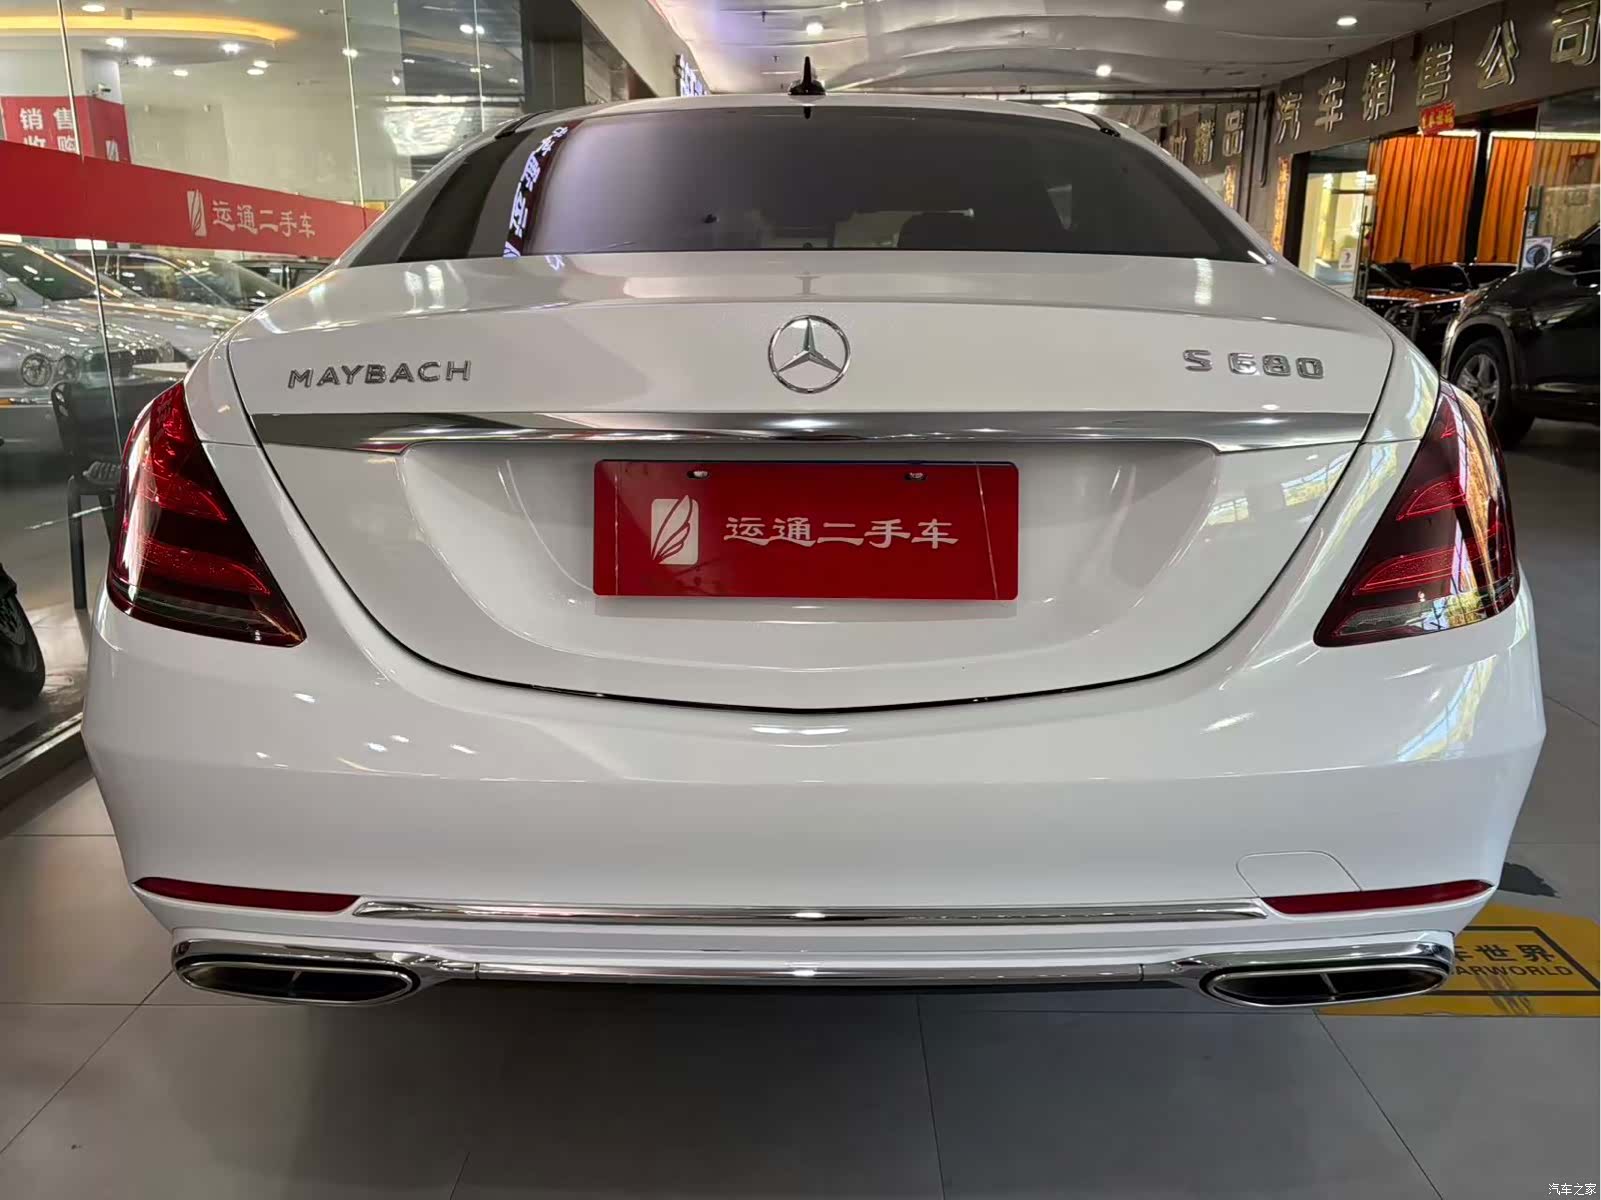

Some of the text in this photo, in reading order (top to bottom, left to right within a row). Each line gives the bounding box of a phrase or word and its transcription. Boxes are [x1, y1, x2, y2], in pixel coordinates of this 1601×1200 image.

[1275, 0, 1599, 144] 汽车销售公司
[20, 107, 74, 130] 销售
[212, 200, 316, 239] 运通二手车
[288, 360, 472, 389] MAYBACH
[1183, 349, 1324, 380] S 680
[723, 516, 960, 549] 运通二手车
[1450, 965, 1573, 976] ARWORLD
